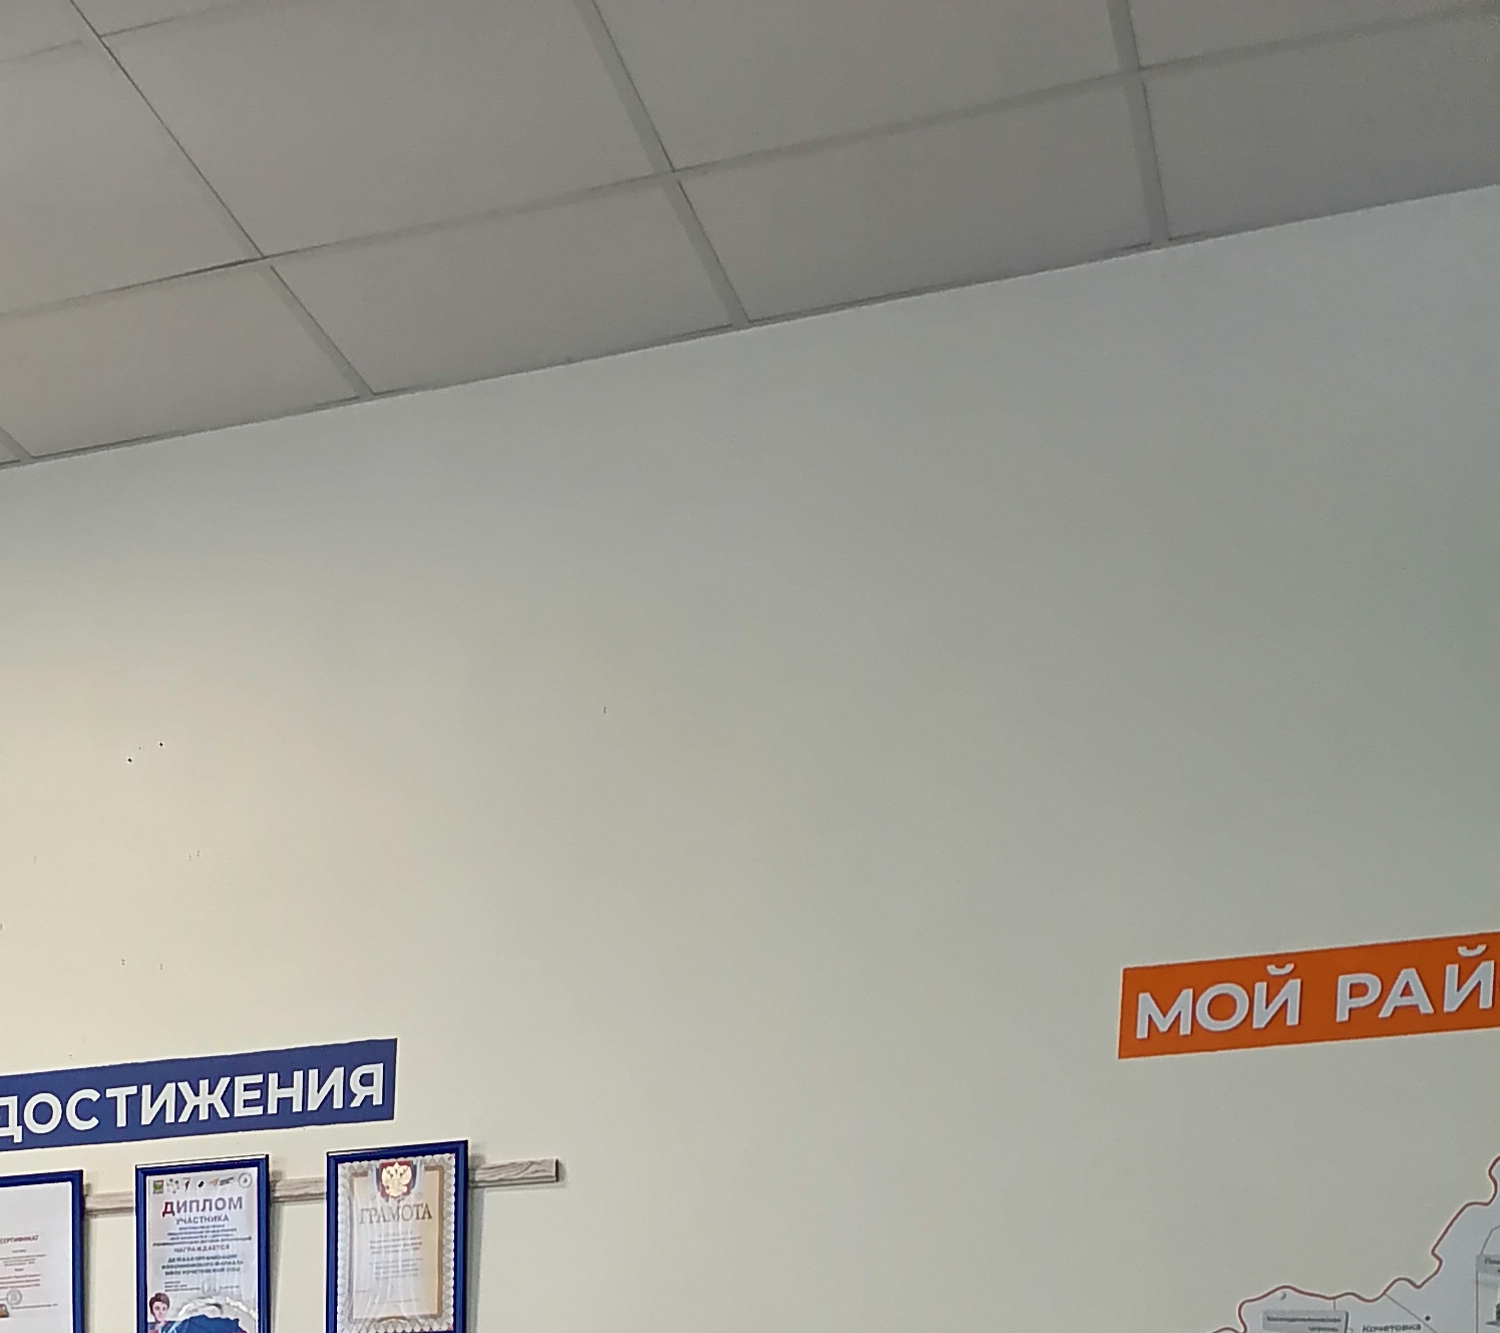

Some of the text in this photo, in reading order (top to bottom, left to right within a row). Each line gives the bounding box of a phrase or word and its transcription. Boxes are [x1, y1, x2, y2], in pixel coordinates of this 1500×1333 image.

[1136, 944, 1495, 1040] МОЙ РАЙ
[162, 1196, 243, 1217] ДИПЛОМ
[360, 1202, 433, 1225] ГРАМОТА
[175, 1215, 230, 1225] УЧАСТНИКА
[1362, 1324, 1421, 1333] Кочетовка
